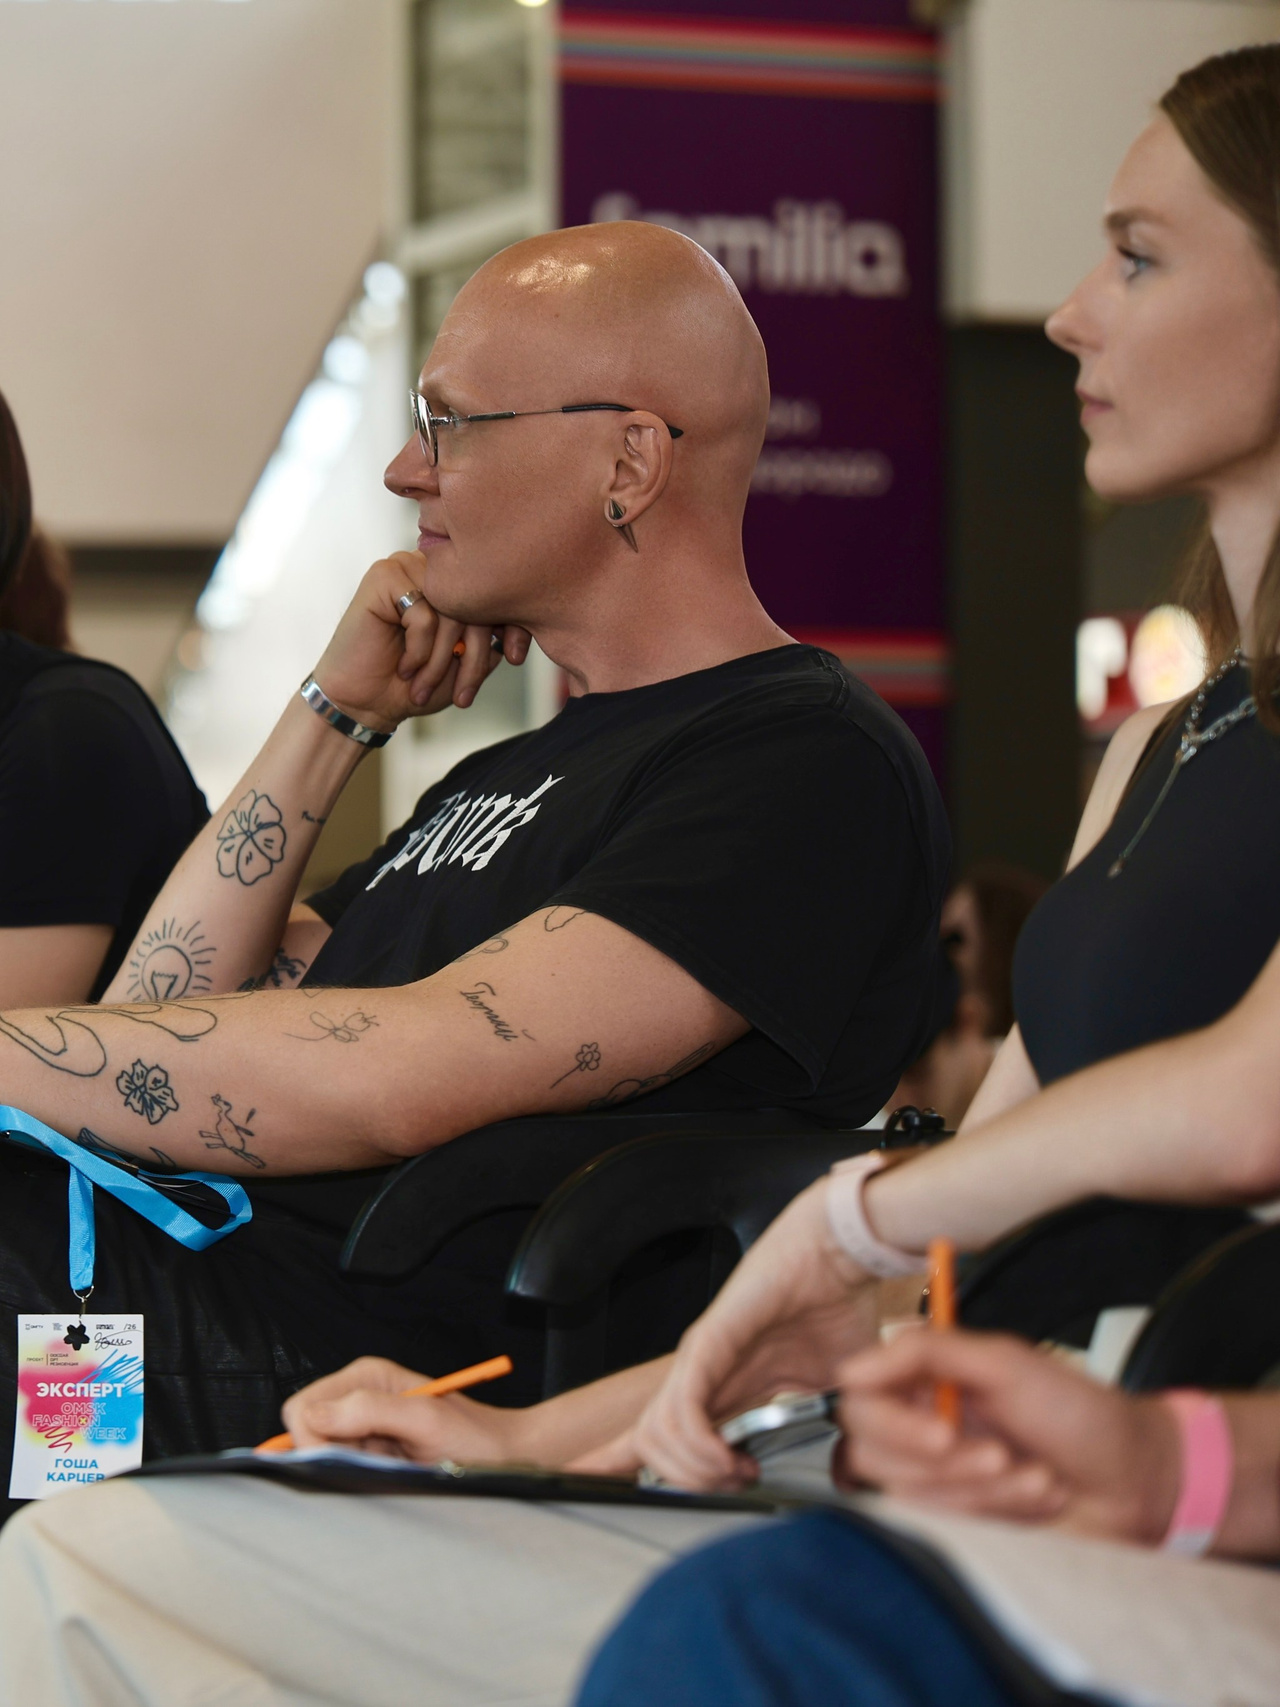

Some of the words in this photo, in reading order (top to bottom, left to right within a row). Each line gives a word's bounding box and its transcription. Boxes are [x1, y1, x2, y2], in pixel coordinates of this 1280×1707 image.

[36, 1382, 126, 1398] ЭКСПЕРТ
[61, 1402, 107, 1415] OMSK
[32, 1414, 101, 1427] FASHION
[81, 1427, 127, 1440] WEEK
[55, 1458, 99, 1469] ГОША
